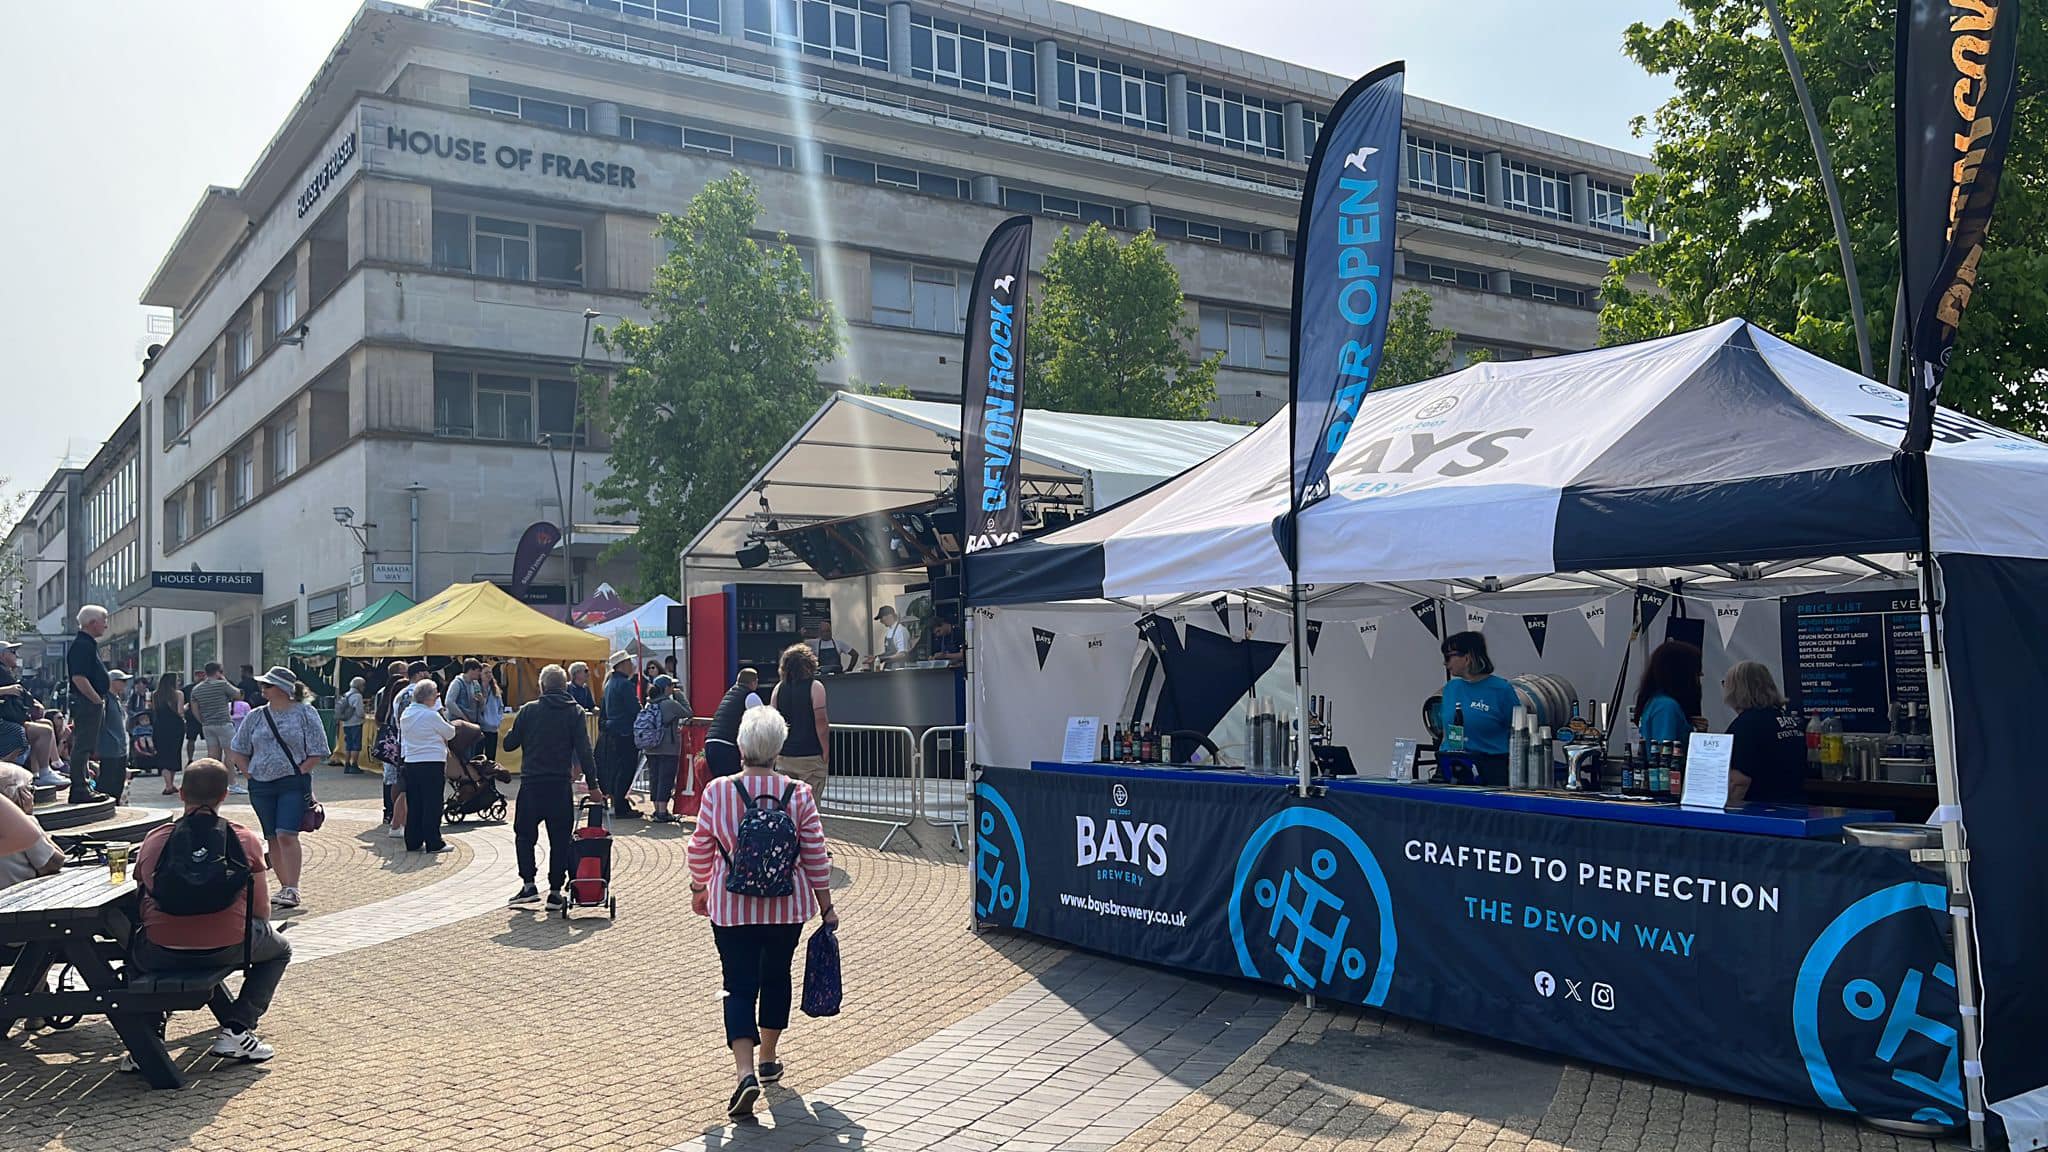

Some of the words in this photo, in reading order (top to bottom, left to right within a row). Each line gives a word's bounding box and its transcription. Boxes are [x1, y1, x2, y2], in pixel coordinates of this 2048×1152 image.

[387, 126, 487, 166] HOUSE
[495, 146, 533, 172] OF
[541, 153, 637, 189] FRASER
[1337, 178, 1382, 327] OPEN
[988, 295, 1015, 395] ROCK
[1326, 343, 1376, 454] BAR
[982, 397, 1015, 513] DEVON
[1330, 427, 1536, 478] AYS
[159, 574, 195, 585] HOUSE
[198, 574, 213, 584] OF
[215, 575, 253, 585] FRASER
[1642, 593, 1663, 607] BAYS
[1215, 602, 1228, 613] BAYS
[1417, 604, 1435, 617] BAYS
[1586, 607, 1605, 620] BAYS
[1717, 608, 1739, 617] BAYS
[1798, 604, 1836, 613] PRICE
[1838, 602, 1863, 612] LIST
[1173, 613, 1186, 623] BAYS
[1467, 612, 1485, 624] BAYS
[1527, 620, 1546, 629] BAYS
[1140, 619, 1156, 632] BAYS
[1359, 623, 1377, 634] BAYS
[1035, 634, 1051, 645] BAYS
[1088, 638, 1103, 649] BAYS
[1470, 701, 1490, 712] BAYS
[1703, 739, 1720, 748] BAYS
[1075, 815, 1168, 877] BAYS
[1097, 869, 1144, 887] BREWERY
[1404, 839, 1523, 875] CRAFTED
[1530, 856, 1567, 882] TO
[1579, 862, 1780, 913] PERFECTION
[1060, 893, 1188, 928] www.baysbrewery.co.uk
[1464, 895, 1513, 925] THE
[1522, 905, 1622, 945] DEVON
[1634, 923, 1696, 957] WAY
